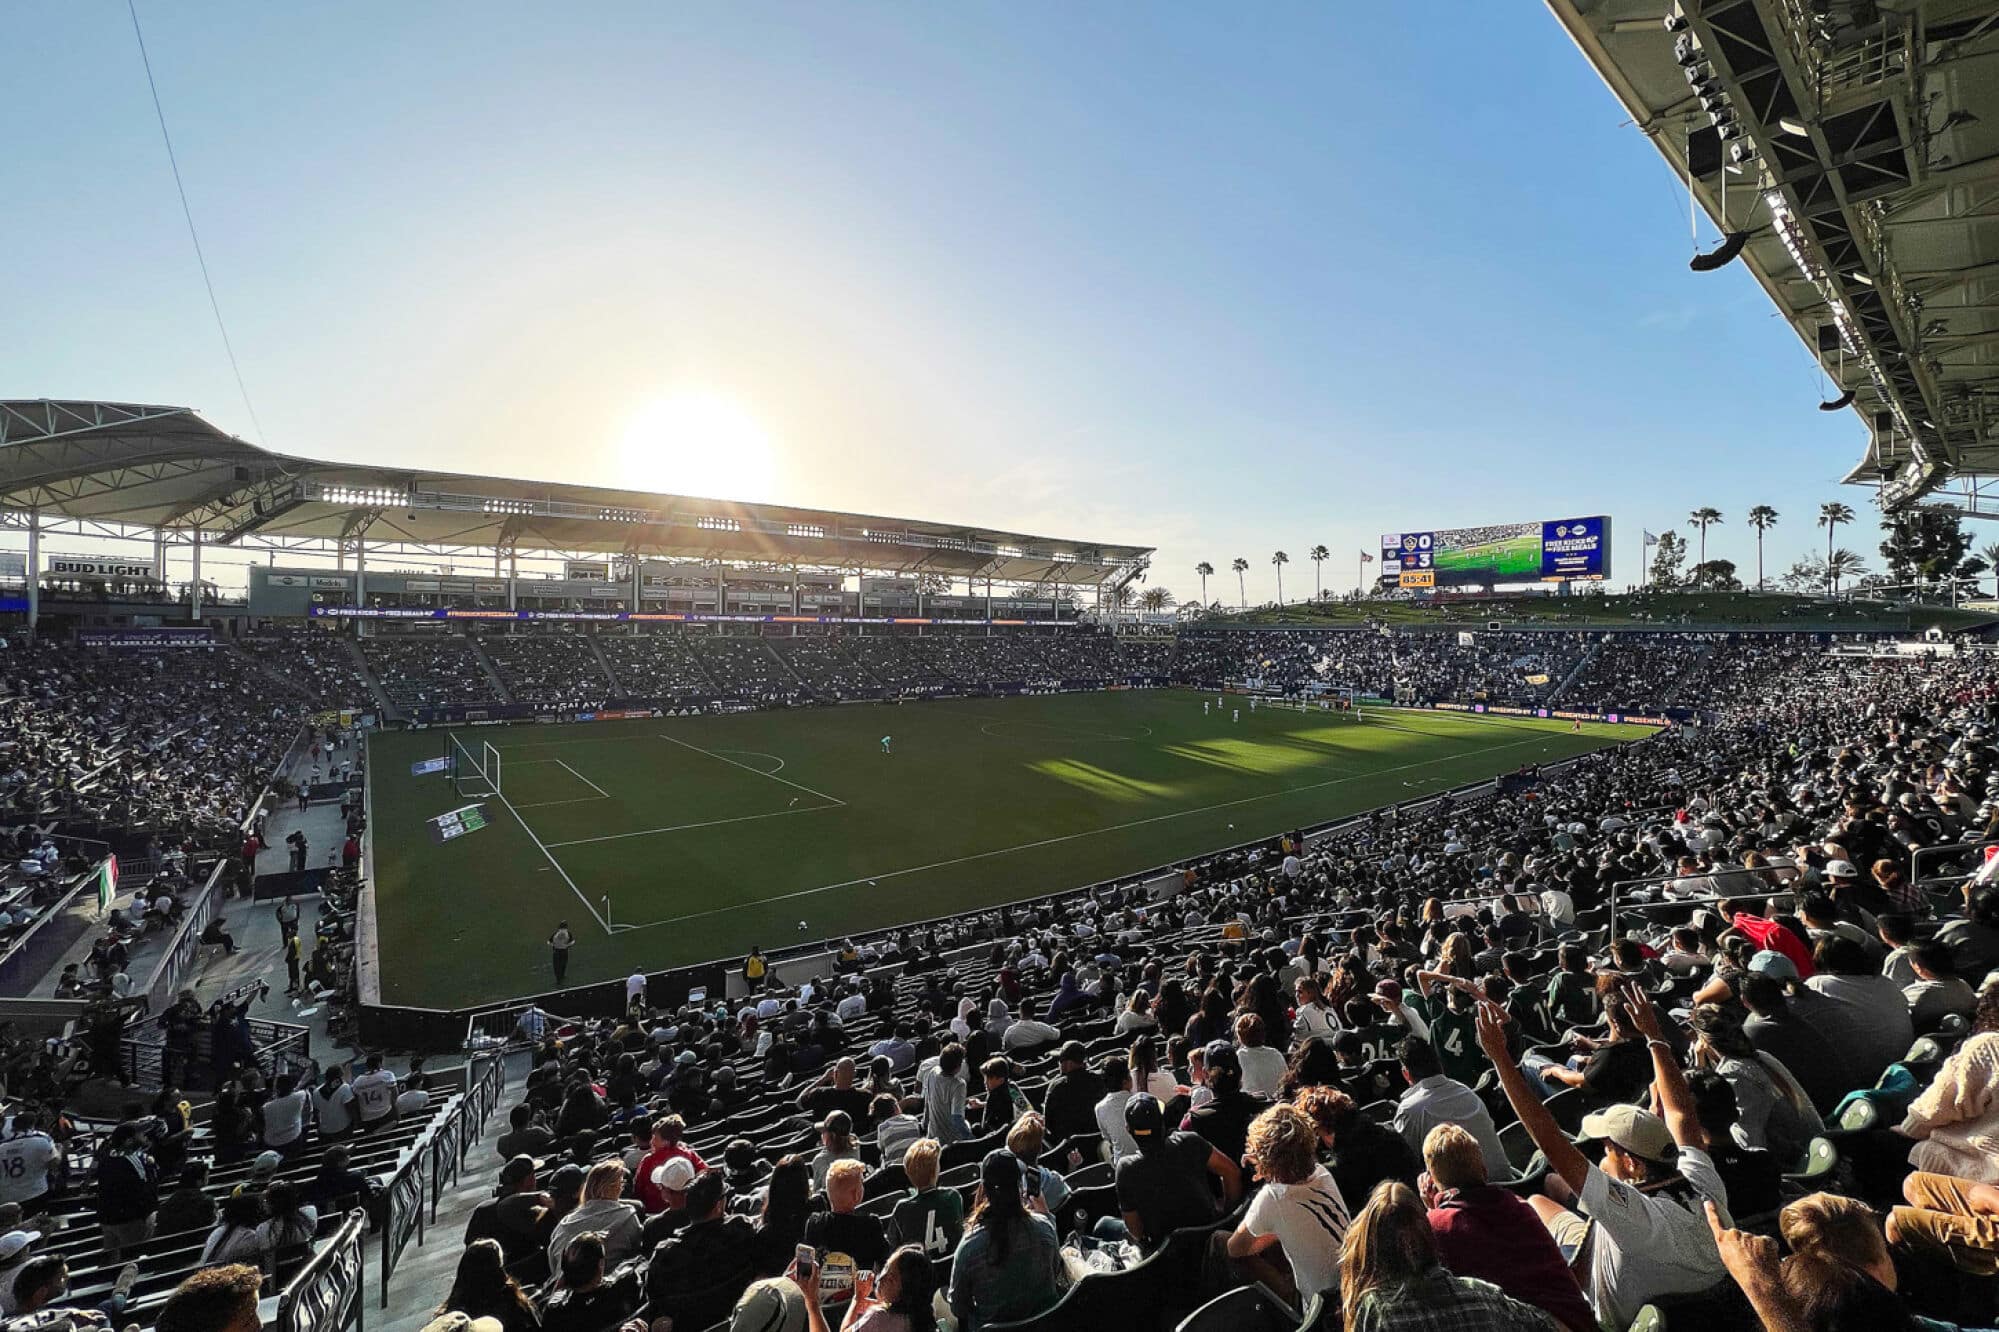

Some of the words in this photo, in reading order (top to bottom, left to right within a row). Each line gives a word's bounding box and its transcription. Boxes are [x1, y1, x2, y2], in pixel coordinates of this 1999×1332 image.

[1419, 535, 1431, 549] 0
[54, 562, 95, 573] BUD
[98, 564, 151, 576] LIGHT
[1419, 554, 1430, 567] 3
[1444, 1027, 1464, 1057] 4
[3, 1157, 26, 1178] 18
[924, 1209, 949, 1253] 4
